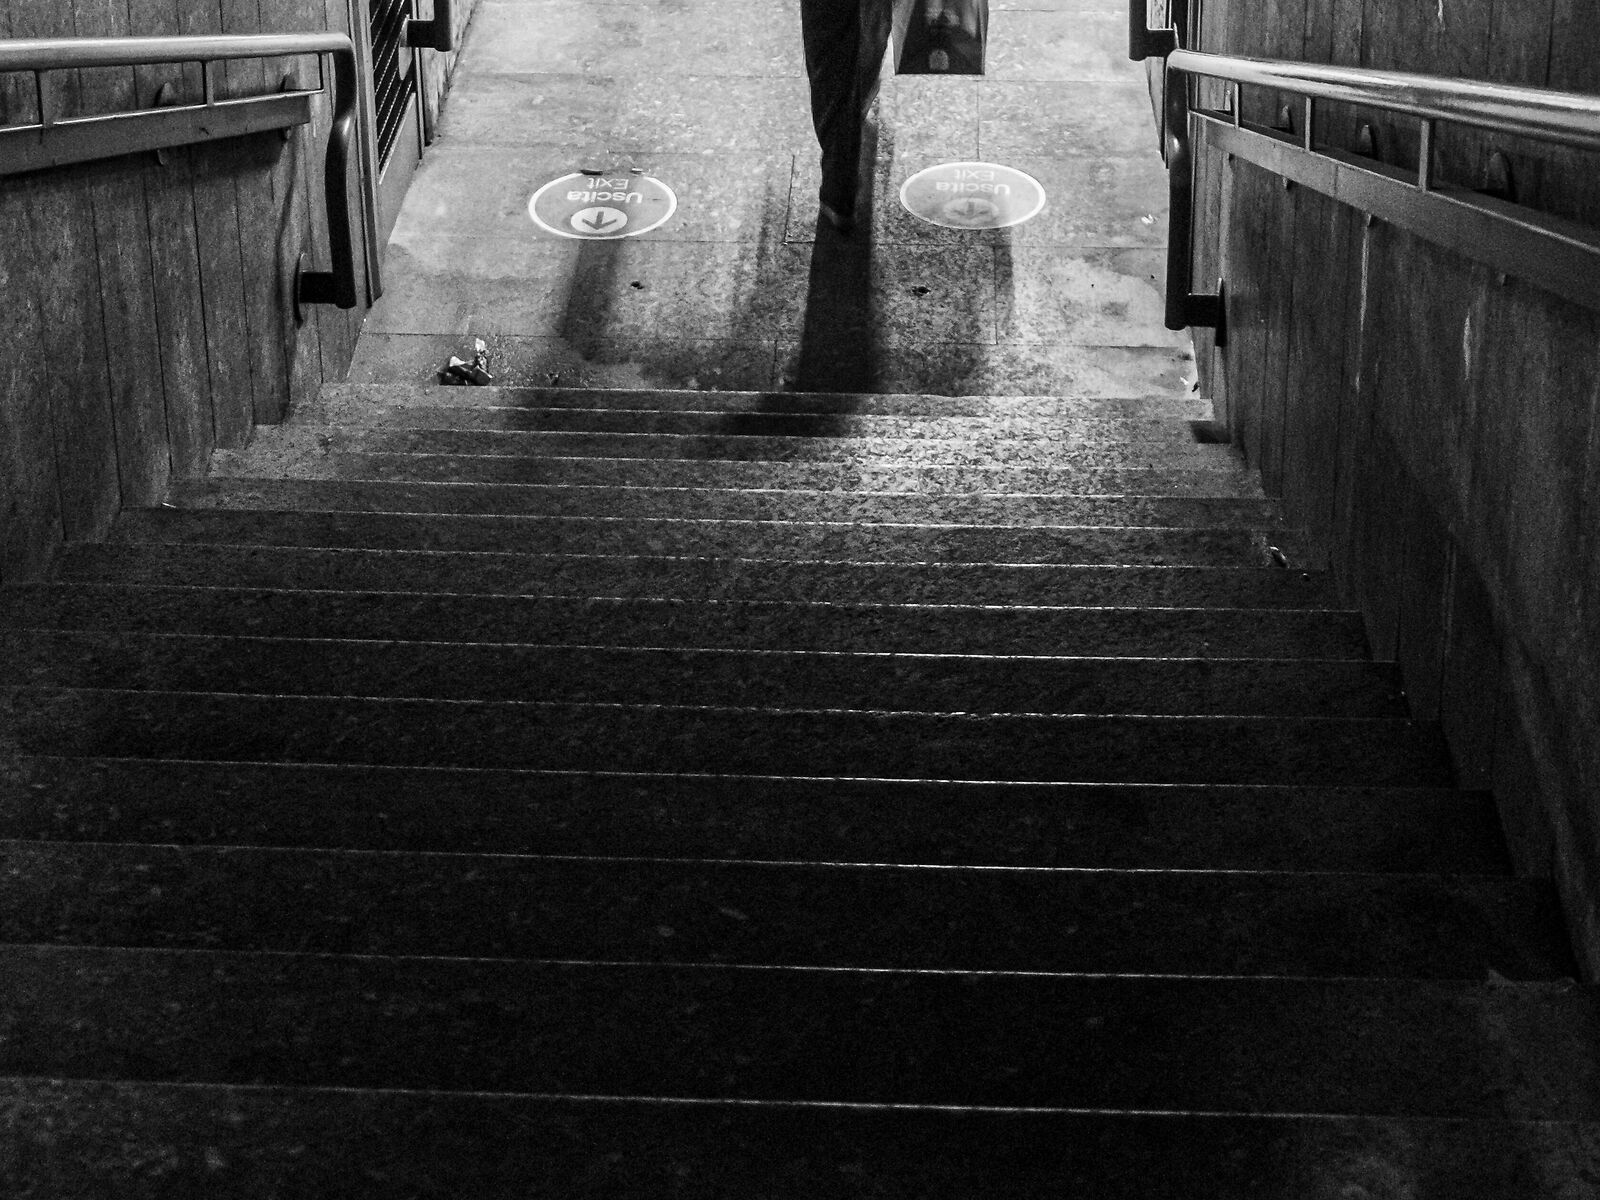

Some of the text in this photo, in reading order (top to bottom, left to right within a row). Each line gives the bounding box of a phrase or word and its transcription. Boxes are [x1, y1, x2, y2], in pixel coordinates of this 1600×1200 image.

[954, 169, 994, 181] Exit
[587, 177, 630, 190] Exit
[936, 182, 1010, 195] Uscita
[567, 190, 643, 204] Uscita
